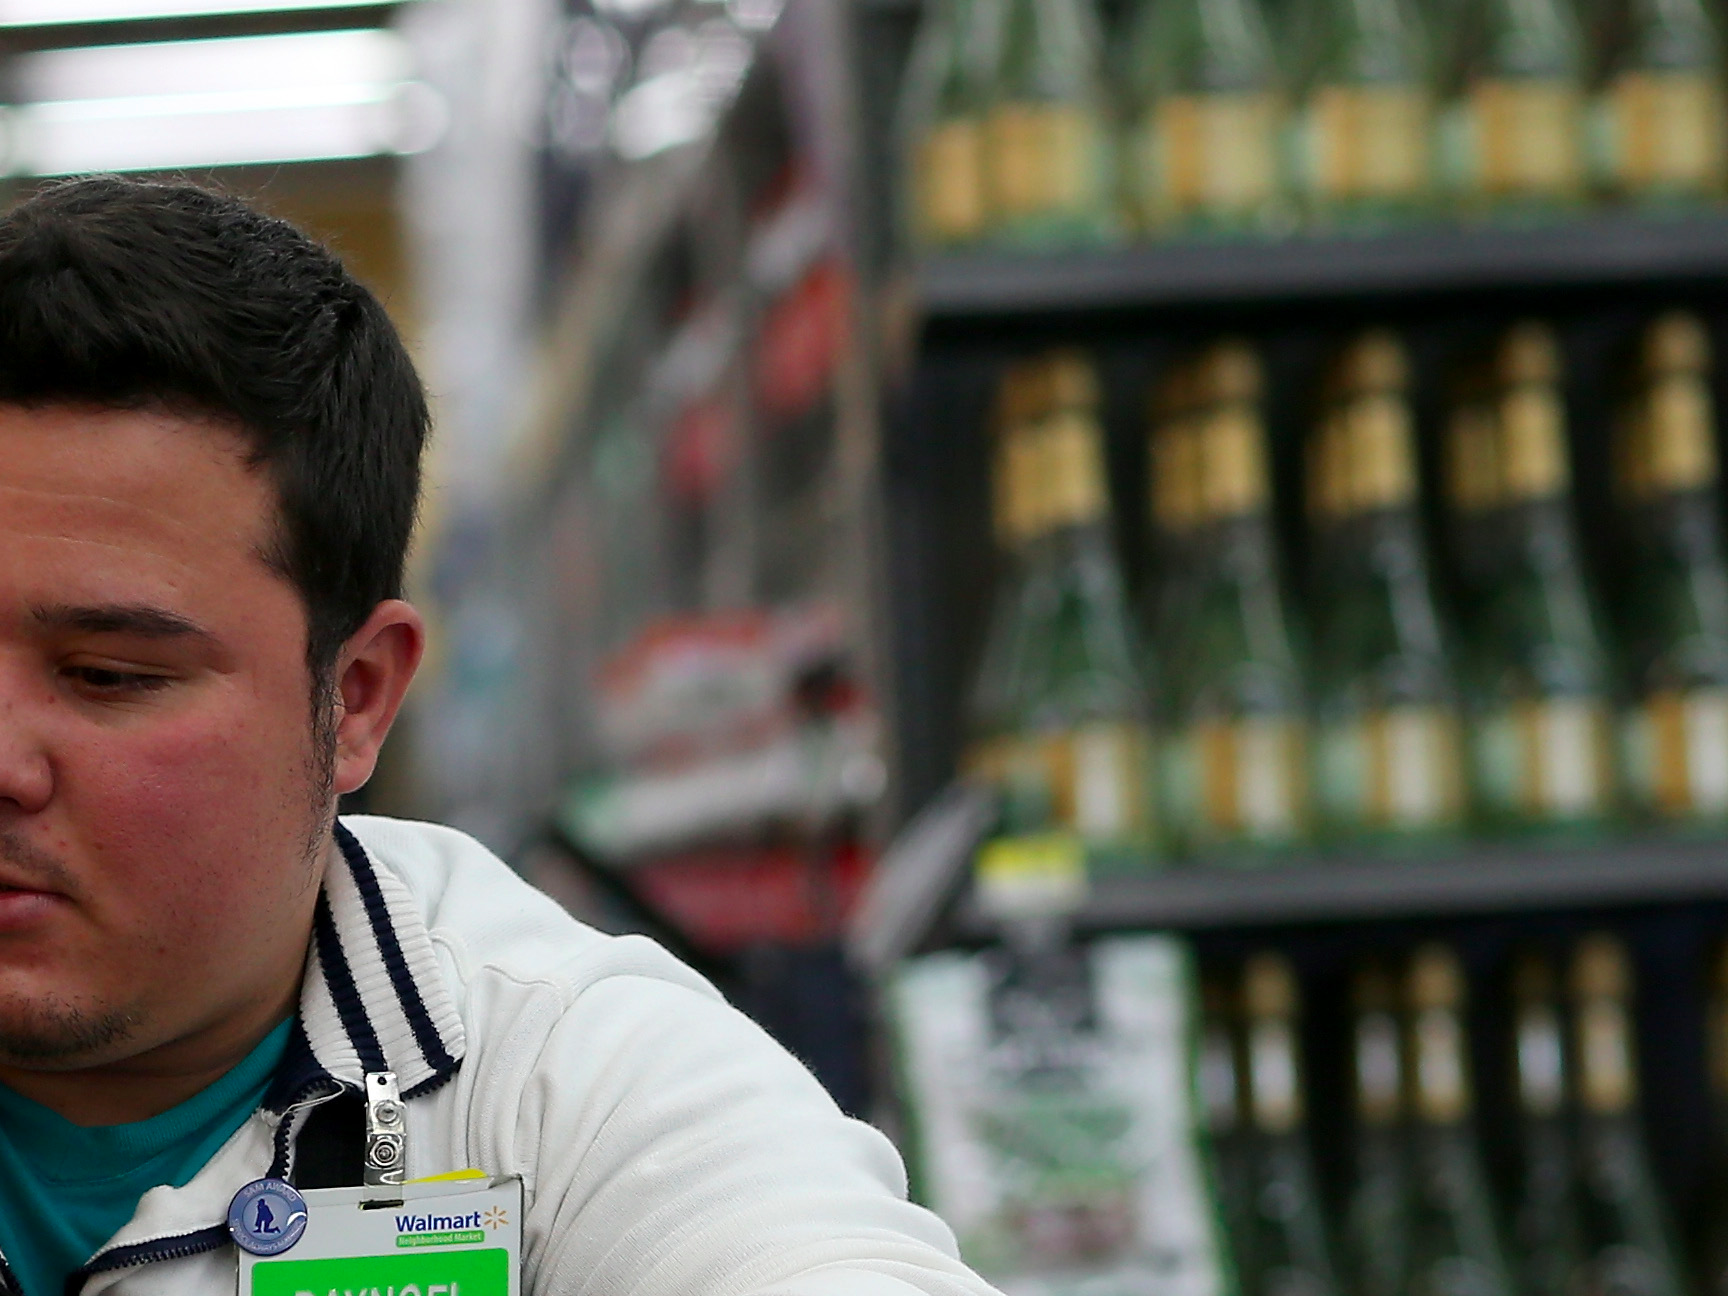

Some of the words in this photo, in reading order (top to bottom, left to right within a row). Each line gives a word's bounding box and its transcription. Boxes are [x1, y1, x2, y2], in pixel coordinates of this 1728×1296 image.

[395, 1211, 481, 1232] Walmart
[398, 1233, 453, 1247] Neighborhood
[454, 1231, 481, 1242] Market
